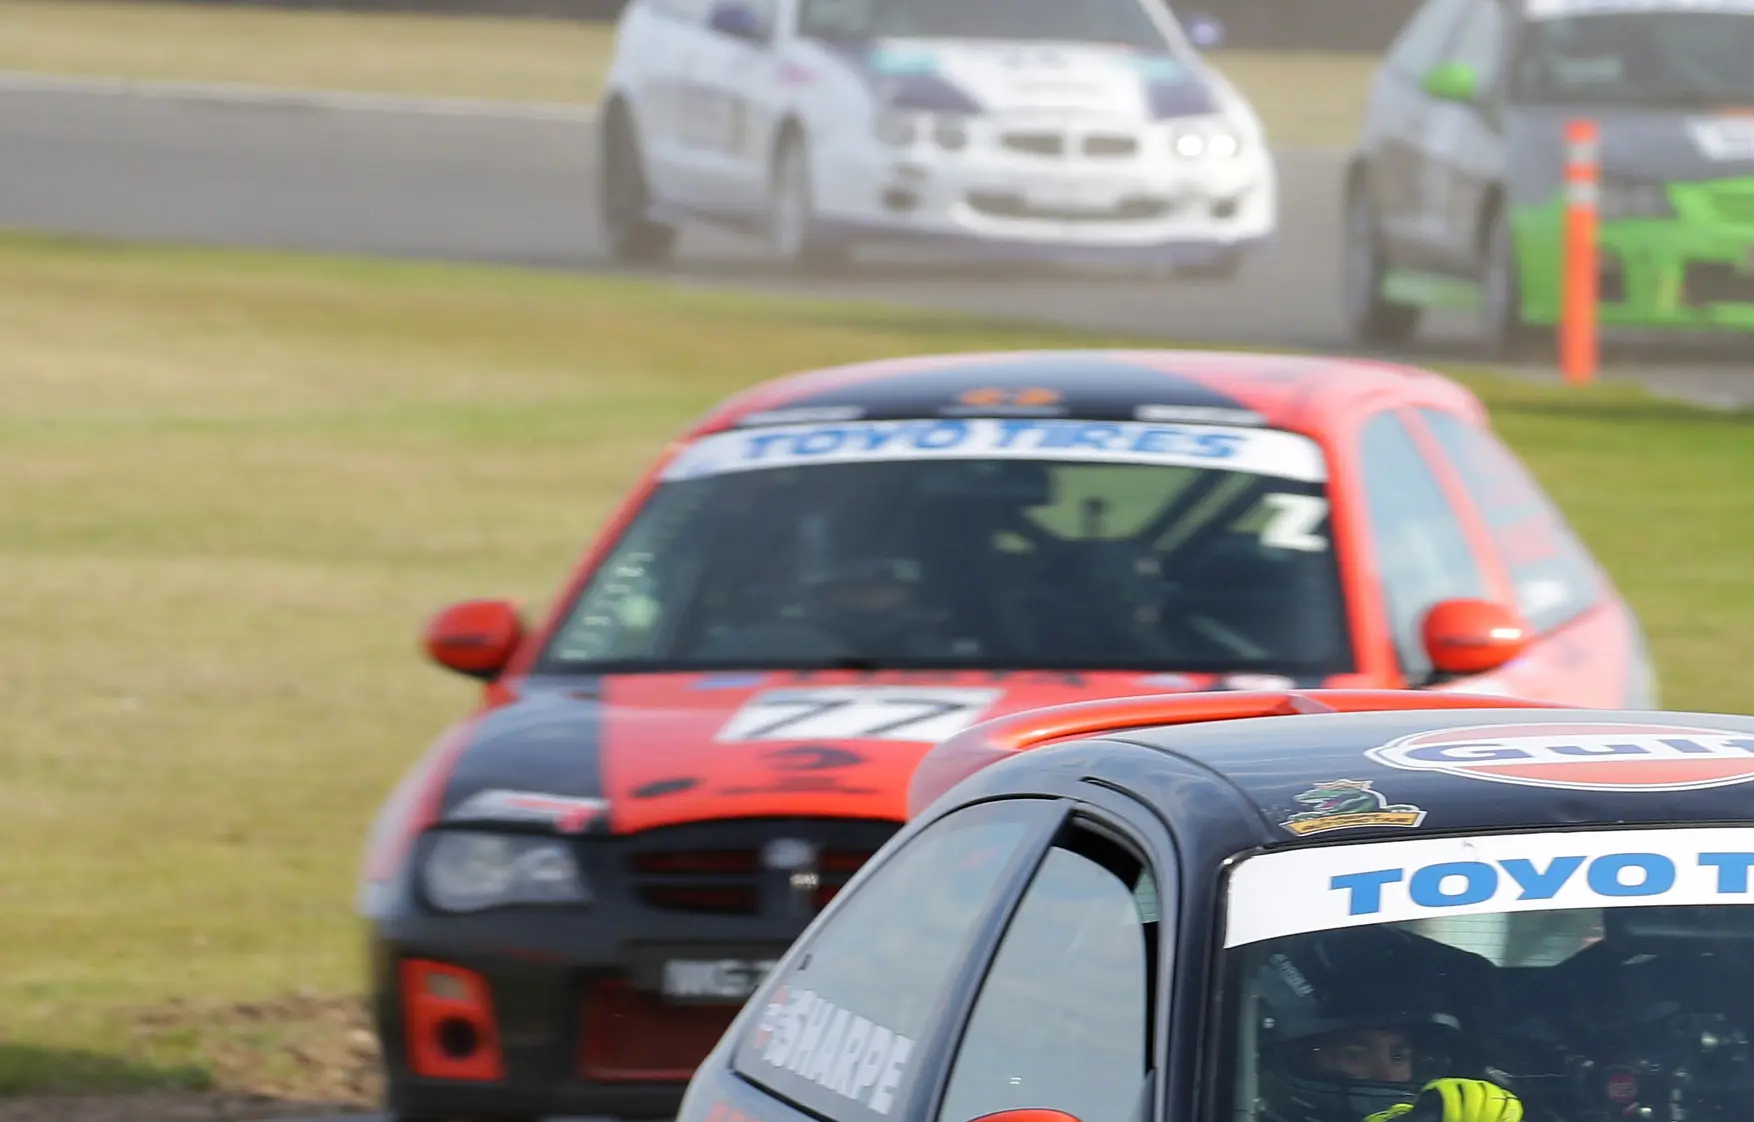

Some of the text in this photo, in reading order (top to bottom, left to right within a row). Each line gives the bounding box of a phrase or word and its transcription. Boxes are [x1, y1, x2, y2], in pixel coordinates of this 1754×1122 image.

[742, 420, 1248, 460] TOYO TIRES
[744, 699, 967, 739] 77
[1329, 851, 1677, 916] TOYO
